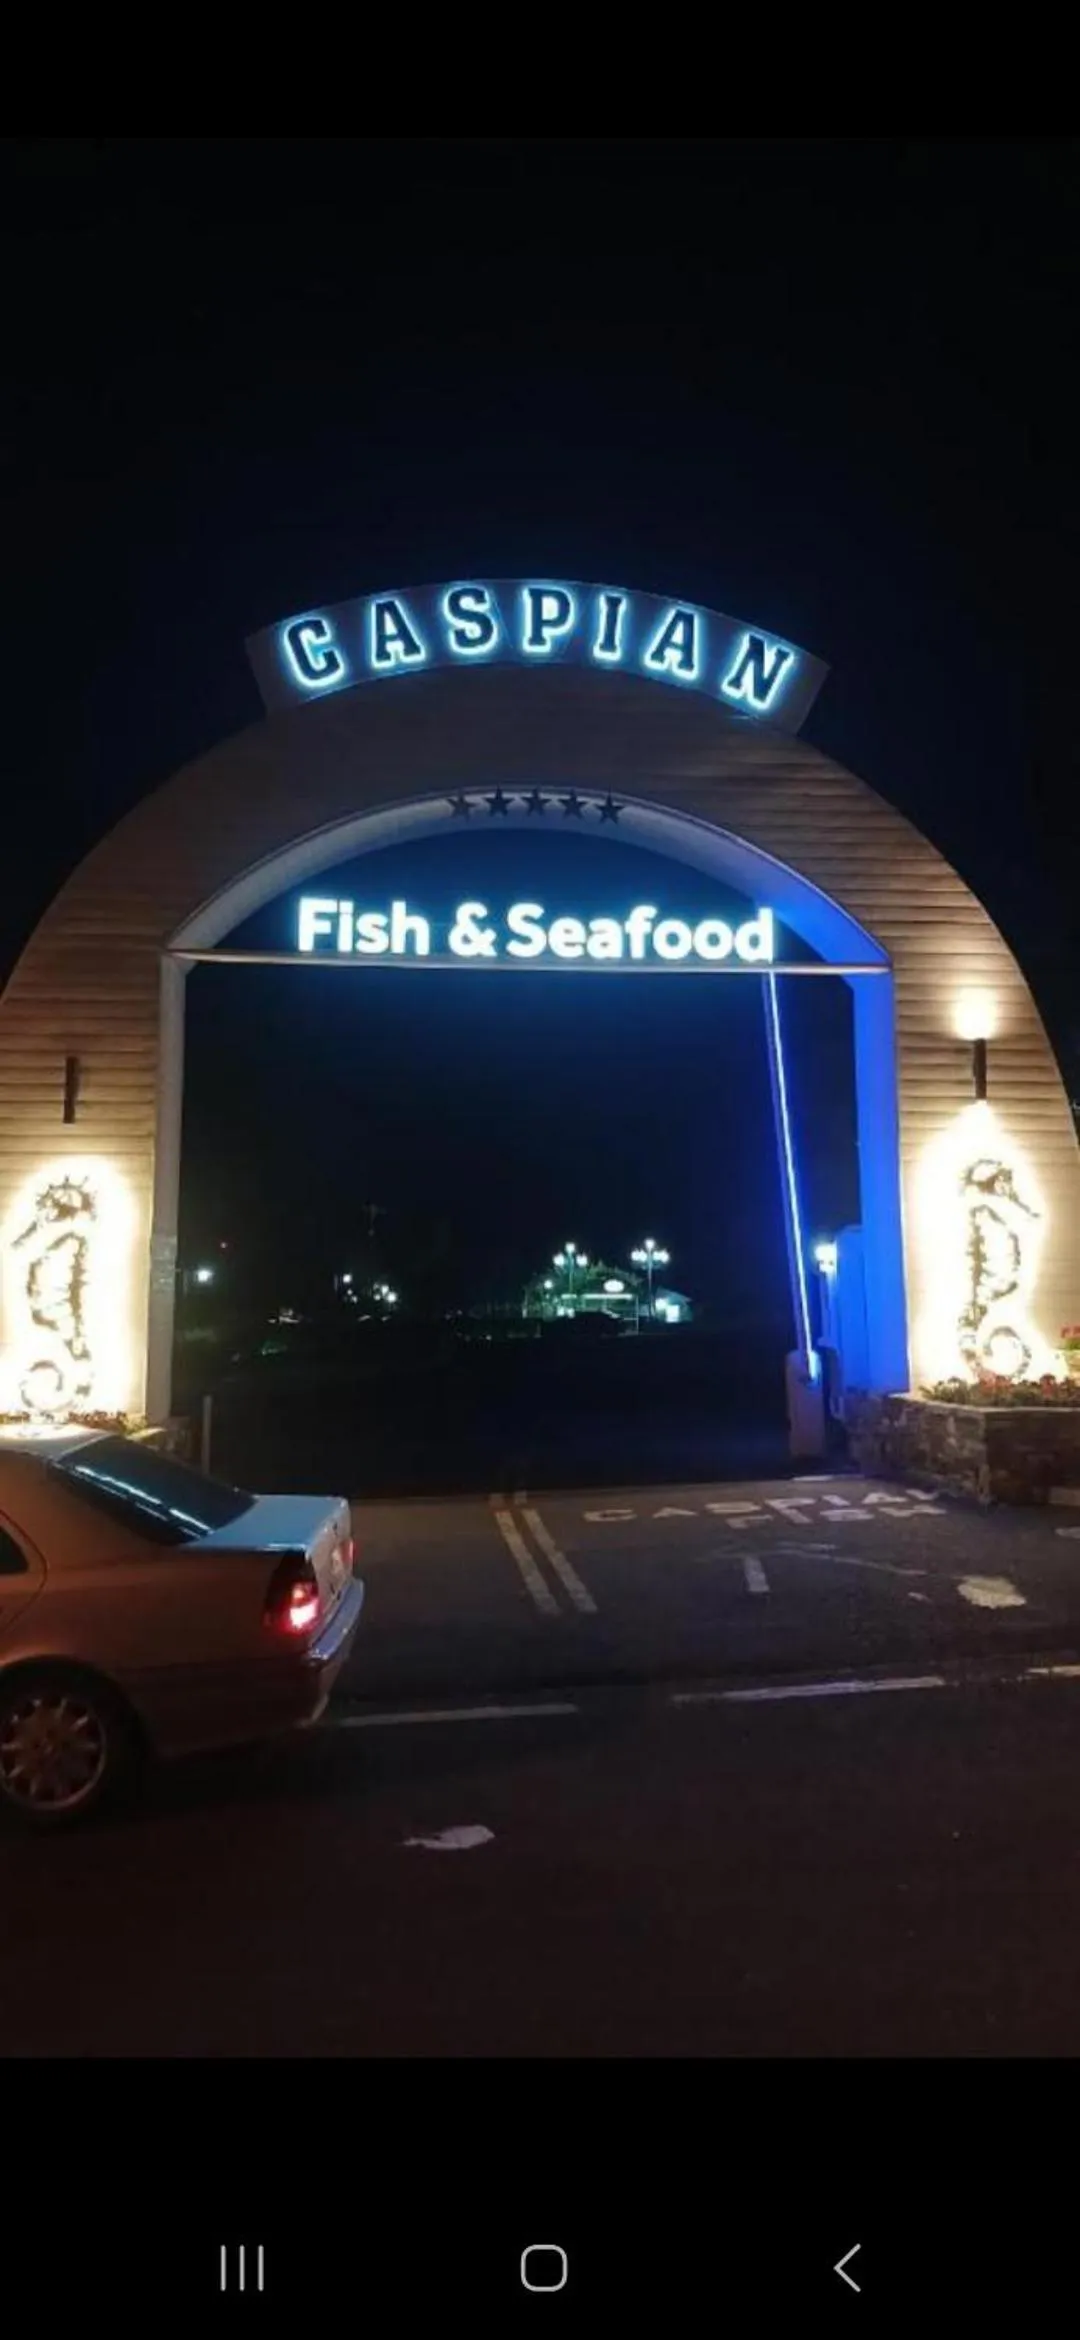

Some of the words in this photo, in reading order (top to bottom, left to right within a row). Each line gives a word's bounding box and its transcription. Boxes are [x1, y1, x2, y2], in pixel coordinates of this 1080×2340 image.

[284, 585, 795, 711] CASPIAN
[298, 898, 431, 954] Fish
[448, 900, 498, 958] &
[507, 903, 776, 962] Seafood
